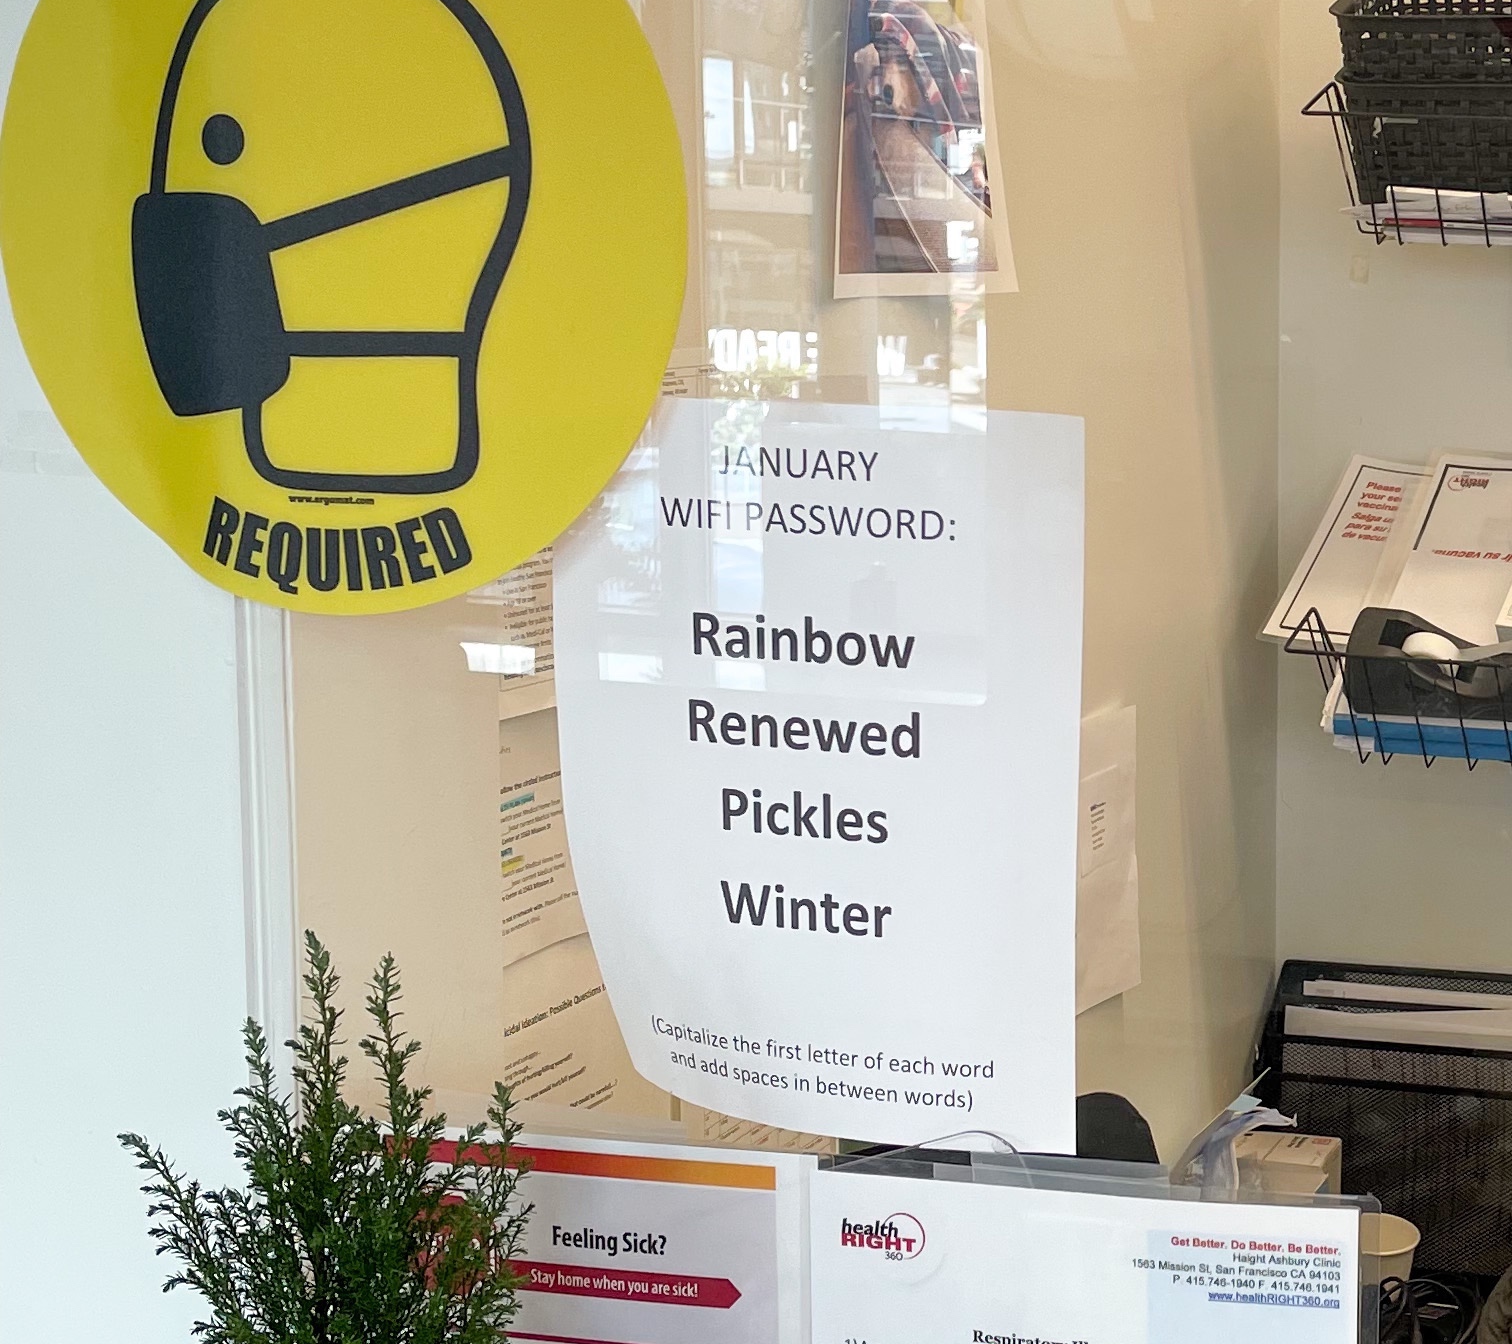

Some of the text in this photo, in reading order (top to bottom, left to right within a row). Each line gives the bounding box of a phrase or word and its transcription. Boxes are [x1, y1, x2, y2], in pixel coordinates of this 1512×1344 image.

[719, 445, 879, 481] JANUARY
[1361, 492, 1385, 502] your
[1366, 482, 1402, 493] Please
[661, 496, 957, 540] WIFI PASSWORD:
[1351, 512, 1382, 523] Salga
[203, 496, 472, 595] REQUIRED
[692, 612, 915, 669] Rainbow
[689, 699, 921, 759] Renewed
[722, 788, 888, 843] Pickles
[720, 881, 892, 938] Winter
[652, 1015, 994, 1079] (Capitalize the first letter of each word
[671, 1049, 973, 1112] and add spaces in between words)
[552, 1225, 667, 1256] Feeling Sick?
[841, 1233, 916, 1252] RIGHT
[842, 1218, 898, 1238] health
[885, 1251, 903, 1261] 360
[1171, 1236, 1341, 1256] Get Better. Do Better. Be Better.
[1233, 1253, 1341, 1268] Haight Ashbury Clinic
[531, 1268, 698, 1298] Stay home when you are sick!
[1208, 1292, 1339, 1309] www.healthRIGHT360.org
